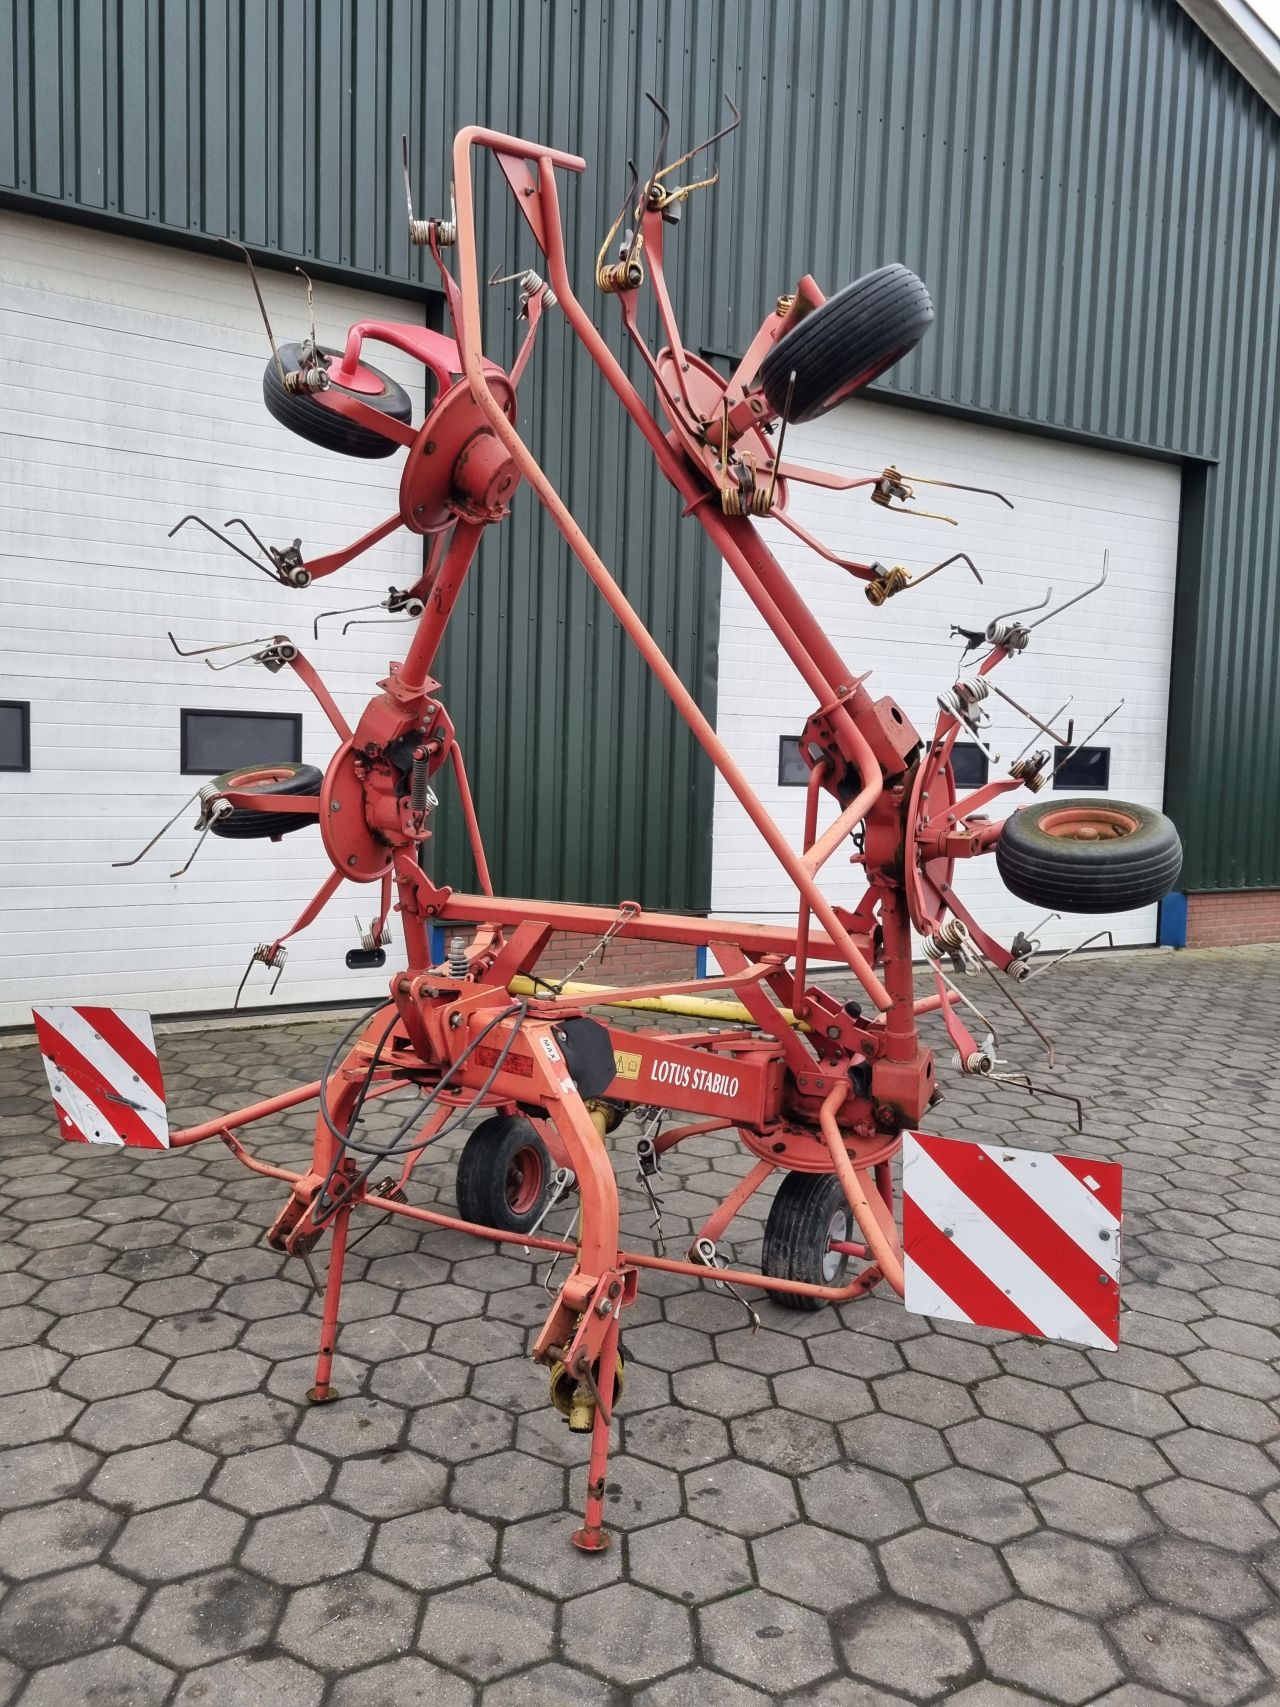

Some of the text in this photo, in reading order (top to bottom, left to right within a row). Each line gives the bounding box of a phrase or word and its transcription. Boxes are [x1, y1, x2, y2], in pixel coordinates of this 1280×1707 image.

[543, 1039, 556, 1059] MAX
[651, 1059, 739, 1098] LOTUS STABILO
